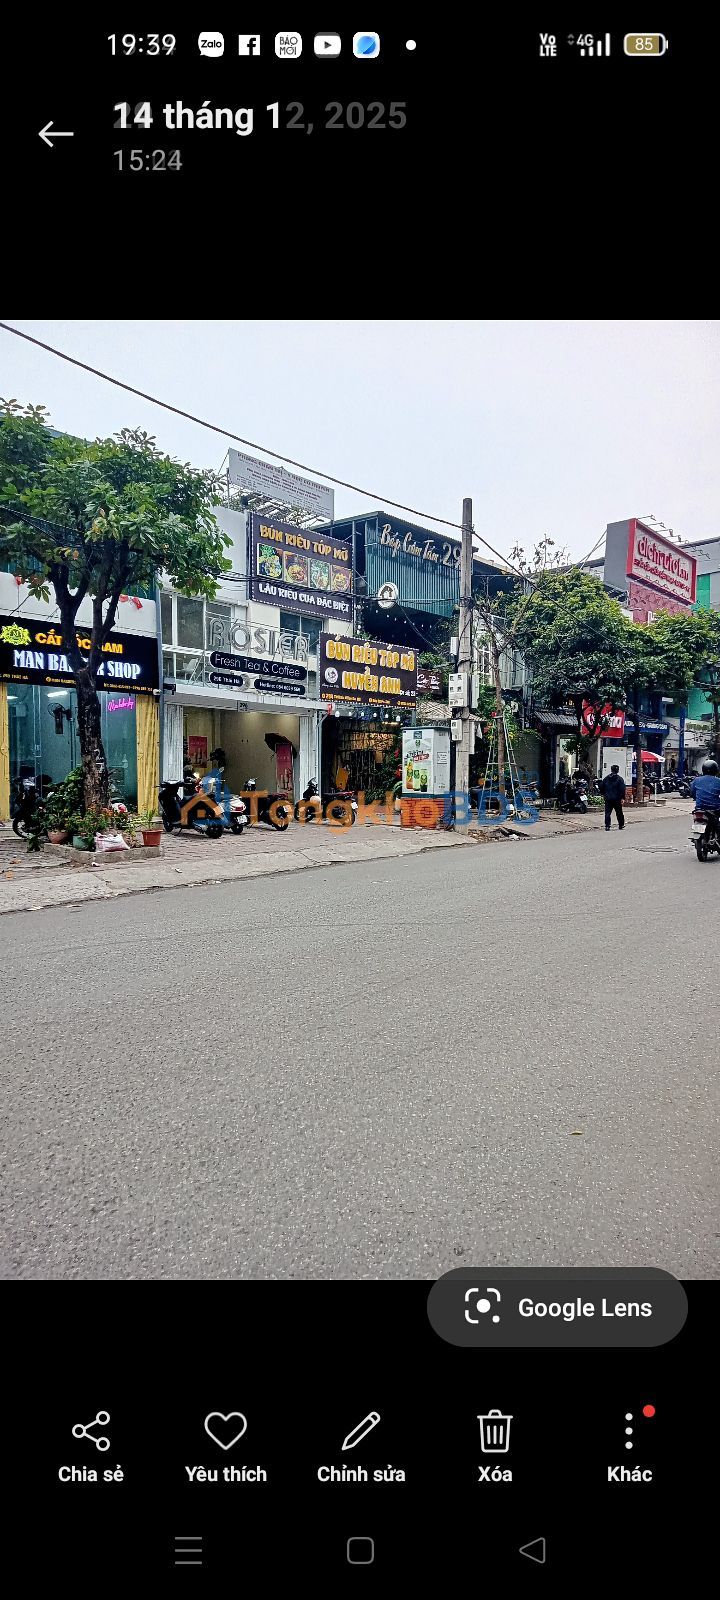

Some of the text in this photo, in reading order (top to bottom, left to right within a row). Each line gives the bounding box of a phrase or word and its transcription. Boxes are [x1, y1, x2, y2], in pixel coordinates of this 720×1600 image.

[107, 33, 177, 56] 19:39
[202, 39, 222, 48] Zalo
[576, 34, 594, 46] 4G
[635, 37, 653, 51] 85
[539, 45, 557, 57] LTE
[162, 100, 254, 136] tháng
[324, 101, 407, 129] 2025
[113, 149, 183, 172] 15:24
[260, 524, 283, 543] BÚN
[299, 593, 315, 605] CUA
[101, 642, 123, 654] AM
[209, 617, 309, 661] ROSIER
[325, 634, 351, 661] BÚN
[13, 649, 45, 670] MAN
[107, 660, 141, 680] SHOP
[214, 653, 300, 677] Fresh Tea & Coffee
[518, 1297, 653, 1322] Google Lens
[58, 1463, 125, 1482] Chia sẻ
[184, 1465, 268, 1482] Yêu thích
[317, 1463, 406, 1482] Chỉnh sửa
[477, 1465, 513, 1482] Xóa
[607, 1465, 653, 1482] Khác
